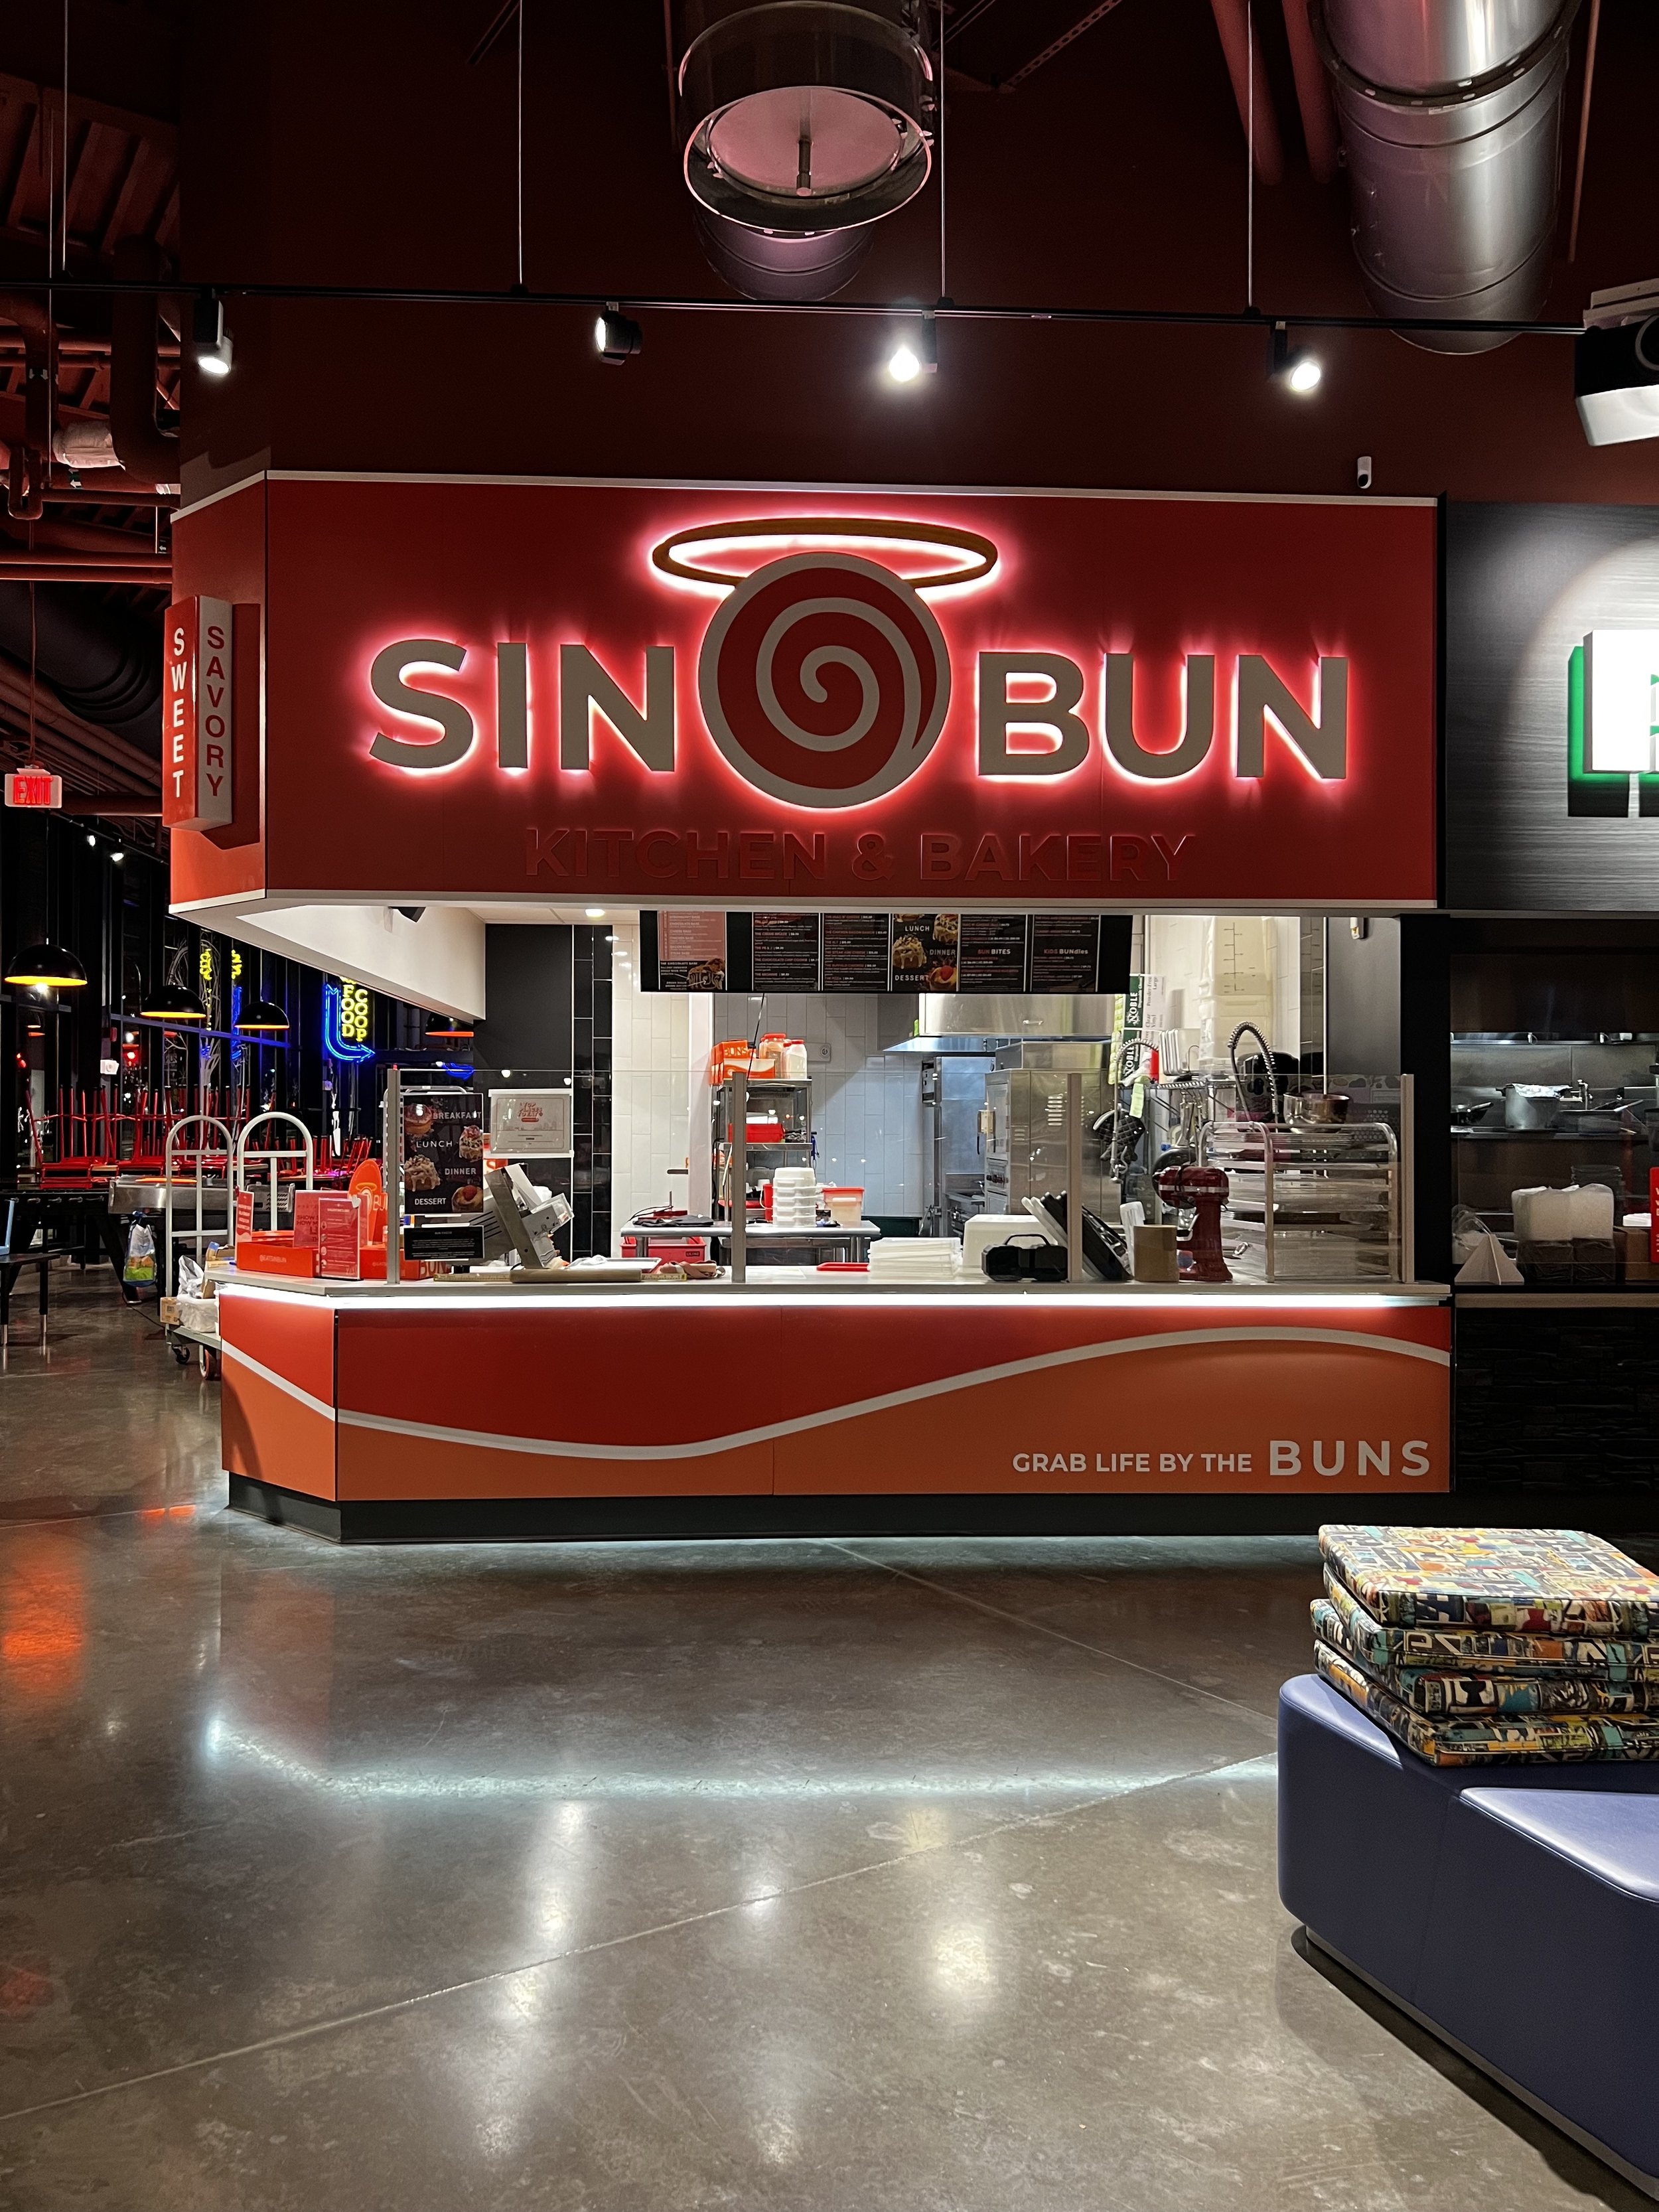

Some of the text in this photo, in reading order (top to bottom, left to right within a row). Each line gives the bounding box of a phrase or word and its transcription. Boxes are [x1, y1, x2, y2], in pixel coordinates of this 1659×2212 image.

[171, 627, 186, 798] SWEET
[206, 626, 225, 796] SAVORY
[369, 638, 1348, 779] SIN BUN
[13, 775, 52, 805] EXIT
[526, 828, 1194, 881] KITCHEN & BAKERY
[341, 984, 355, 1037] FOOD
[354, 989, 368, 1042] COOP
[1128, 992, 1138, 1023] NOBLE
[724, 1047, 748, 1057] BUNS
[433, 1111, 482, 1120] BREAKFAT
[373, 1195, 388, 1211] BU
[1013, 1439, 1430, 1477] GRAB LIFE BY THE BUNS
